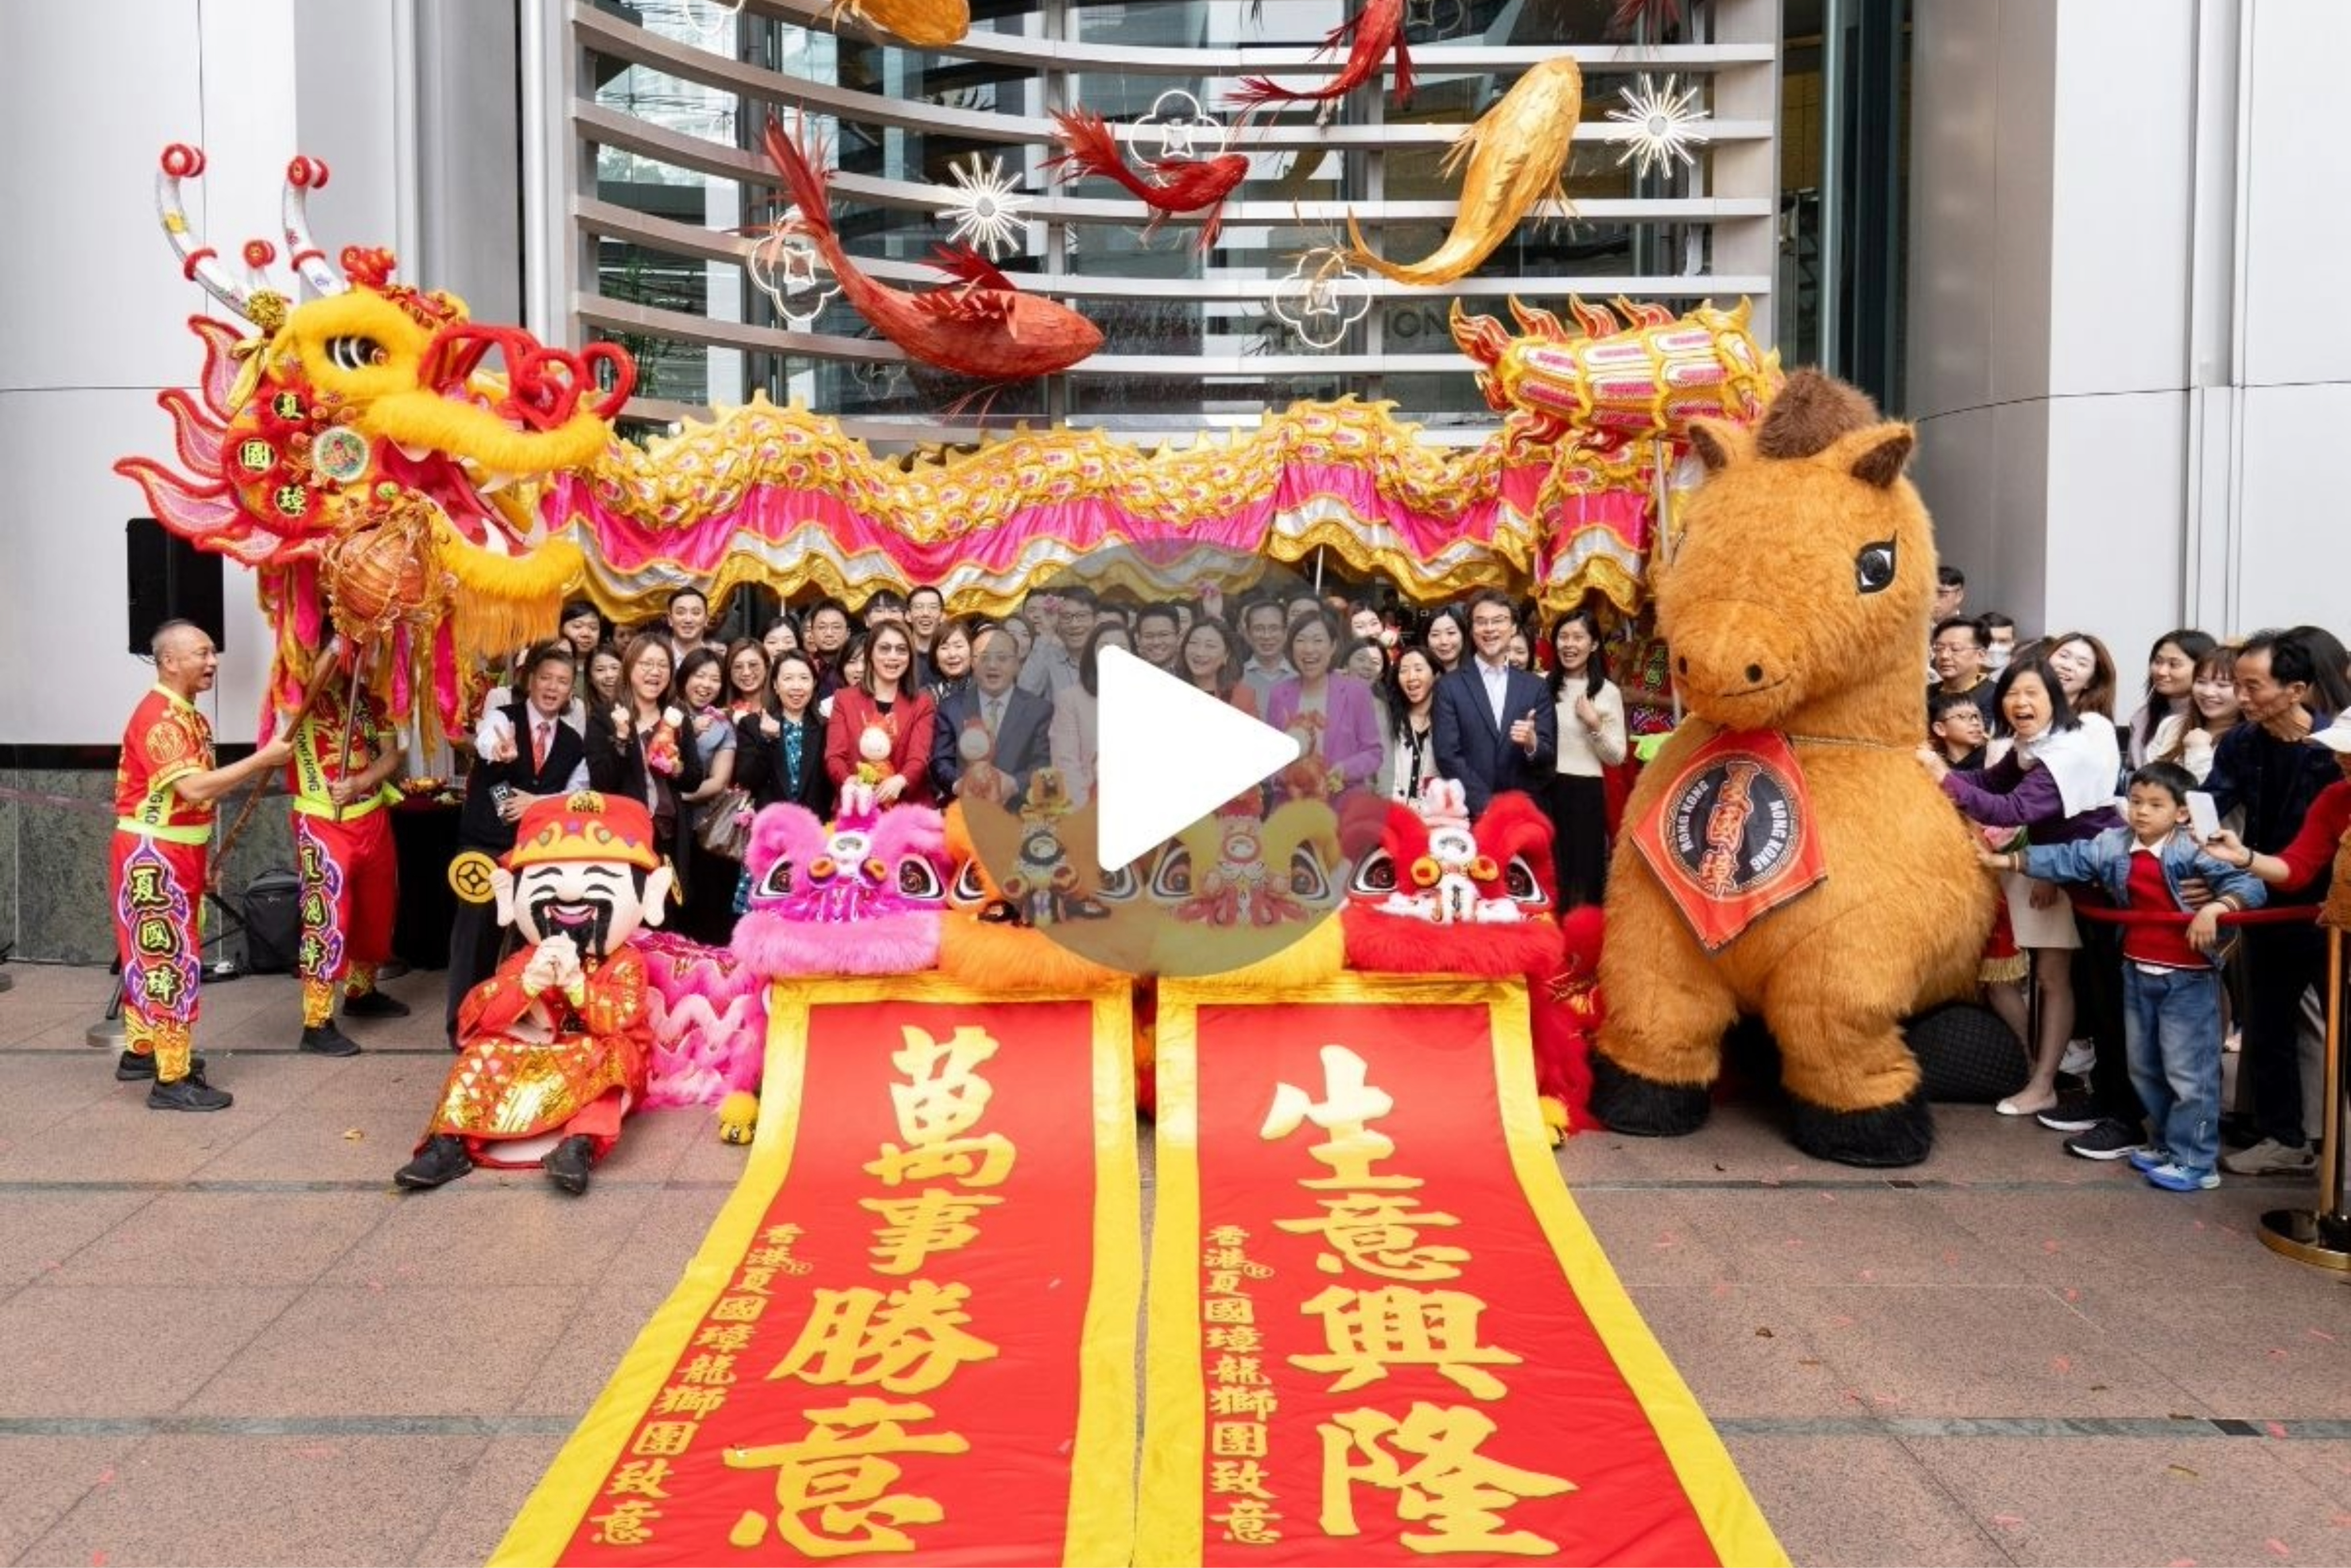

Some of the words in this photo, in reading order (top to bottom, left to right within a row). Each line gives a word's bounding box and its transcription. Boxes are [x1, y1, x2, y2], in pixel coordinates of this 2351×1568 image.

[1681, 779, 1709, 814] KONG
[1677, 815, 1694, 853] HONG
[1768, 799, 1788, 839] HONG
[1749, 839, 1784, 872] KONG
[722, 1025, 1017, 1557] 萬事勝意
[1259, 1045, 1580, 1555] 生意興隆
